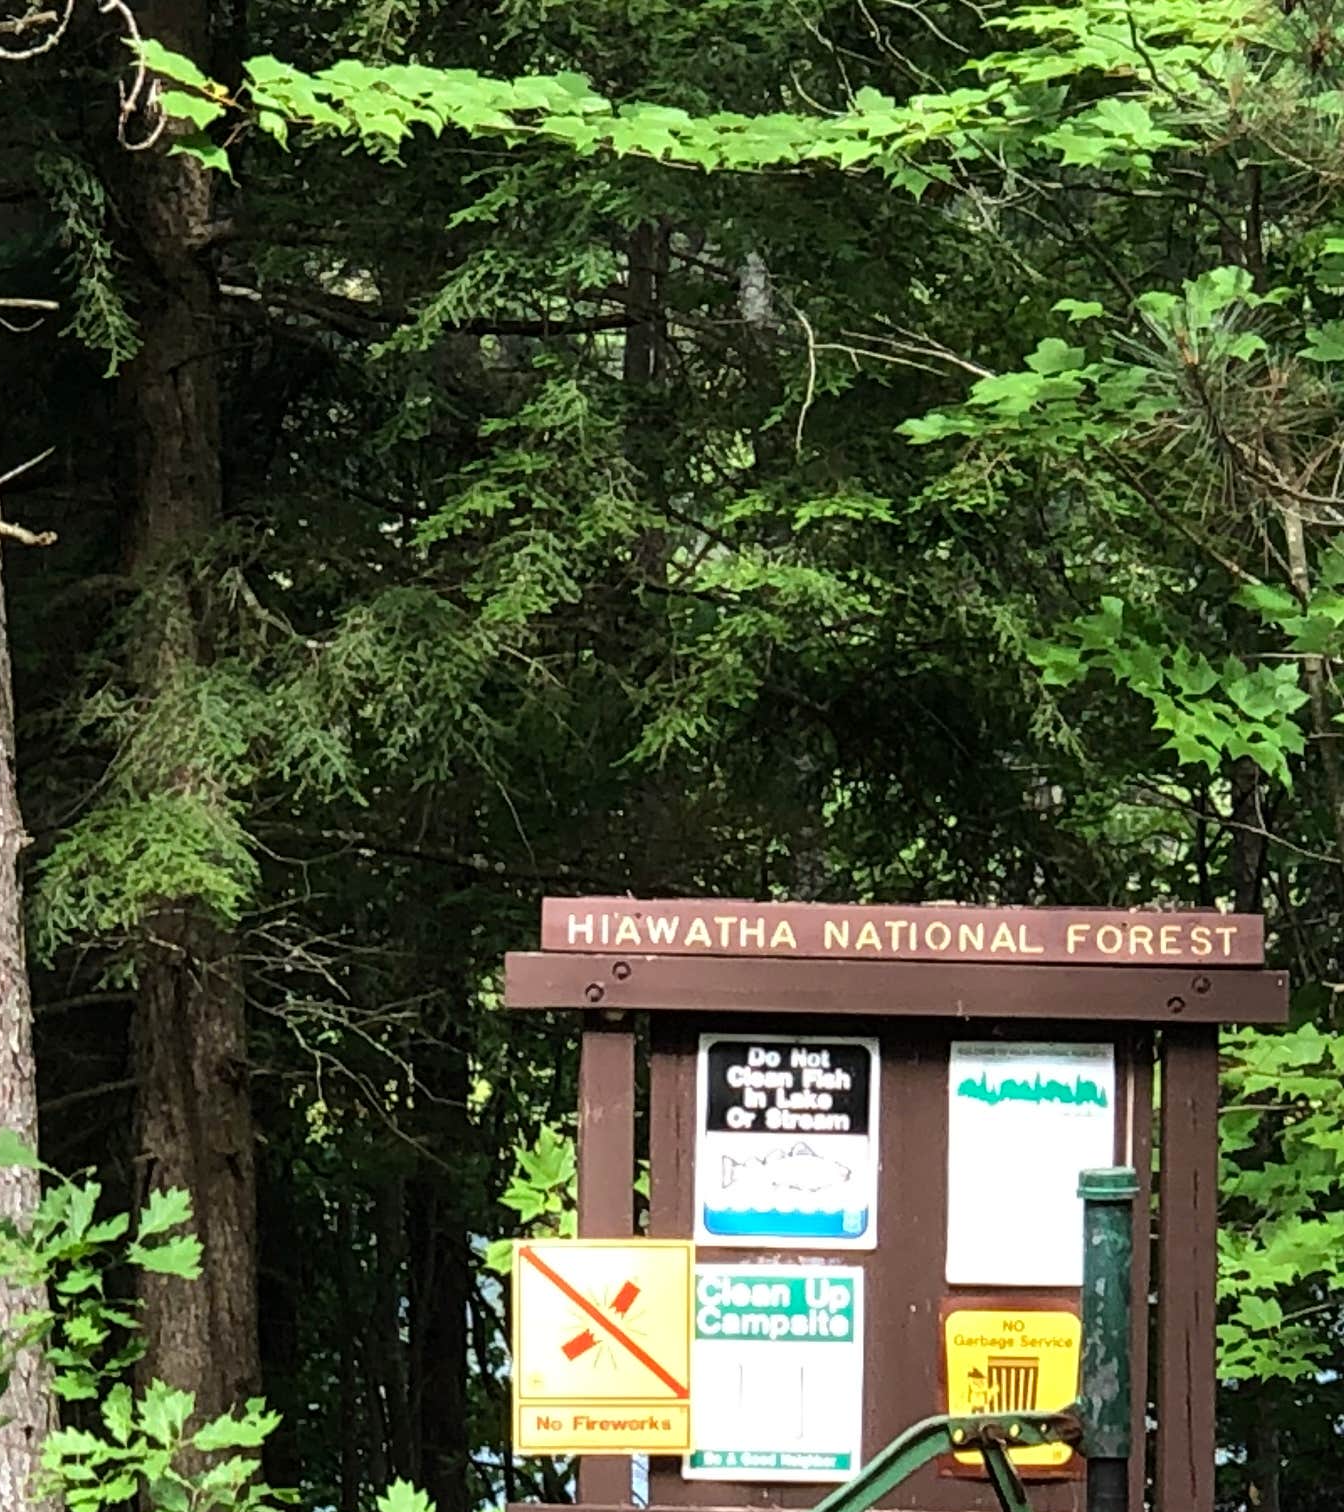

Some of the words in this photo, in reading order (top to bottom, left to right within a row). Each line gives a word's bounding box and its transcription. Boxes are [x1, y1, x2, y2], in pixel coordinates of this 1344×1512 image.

[568, 913, 798, 950] HIAWATHA
[824, 919, 1044, 954] NATIONAL
[1067, 923, 1238, 957] FOREST
[748, 1046, 782, 1067] Do
[790, 1047, 831, 1069] Not
[726, 1065, 794, 1089] Clean
[802, 1067, 852, 1091] Fish
[776, 1087, 834, 1111] Lake
[726, 1106, 757, 1130] Or
[765, 1107, 851, 1132] Stream
[697, 1275, 792, 1308] Clean
[805, 1277, 851, 1314] Up
[696, 1305, 850, 1341] Campsite
[1002, 1319, 1026, 1332] NO
[953, 1333, 1015, 1350] Garbage
[1020, 1334, 1074, 1349] Service
[536, 1415, 564, 1432] No
[572, 1415, 673, 1432] Fireworks
